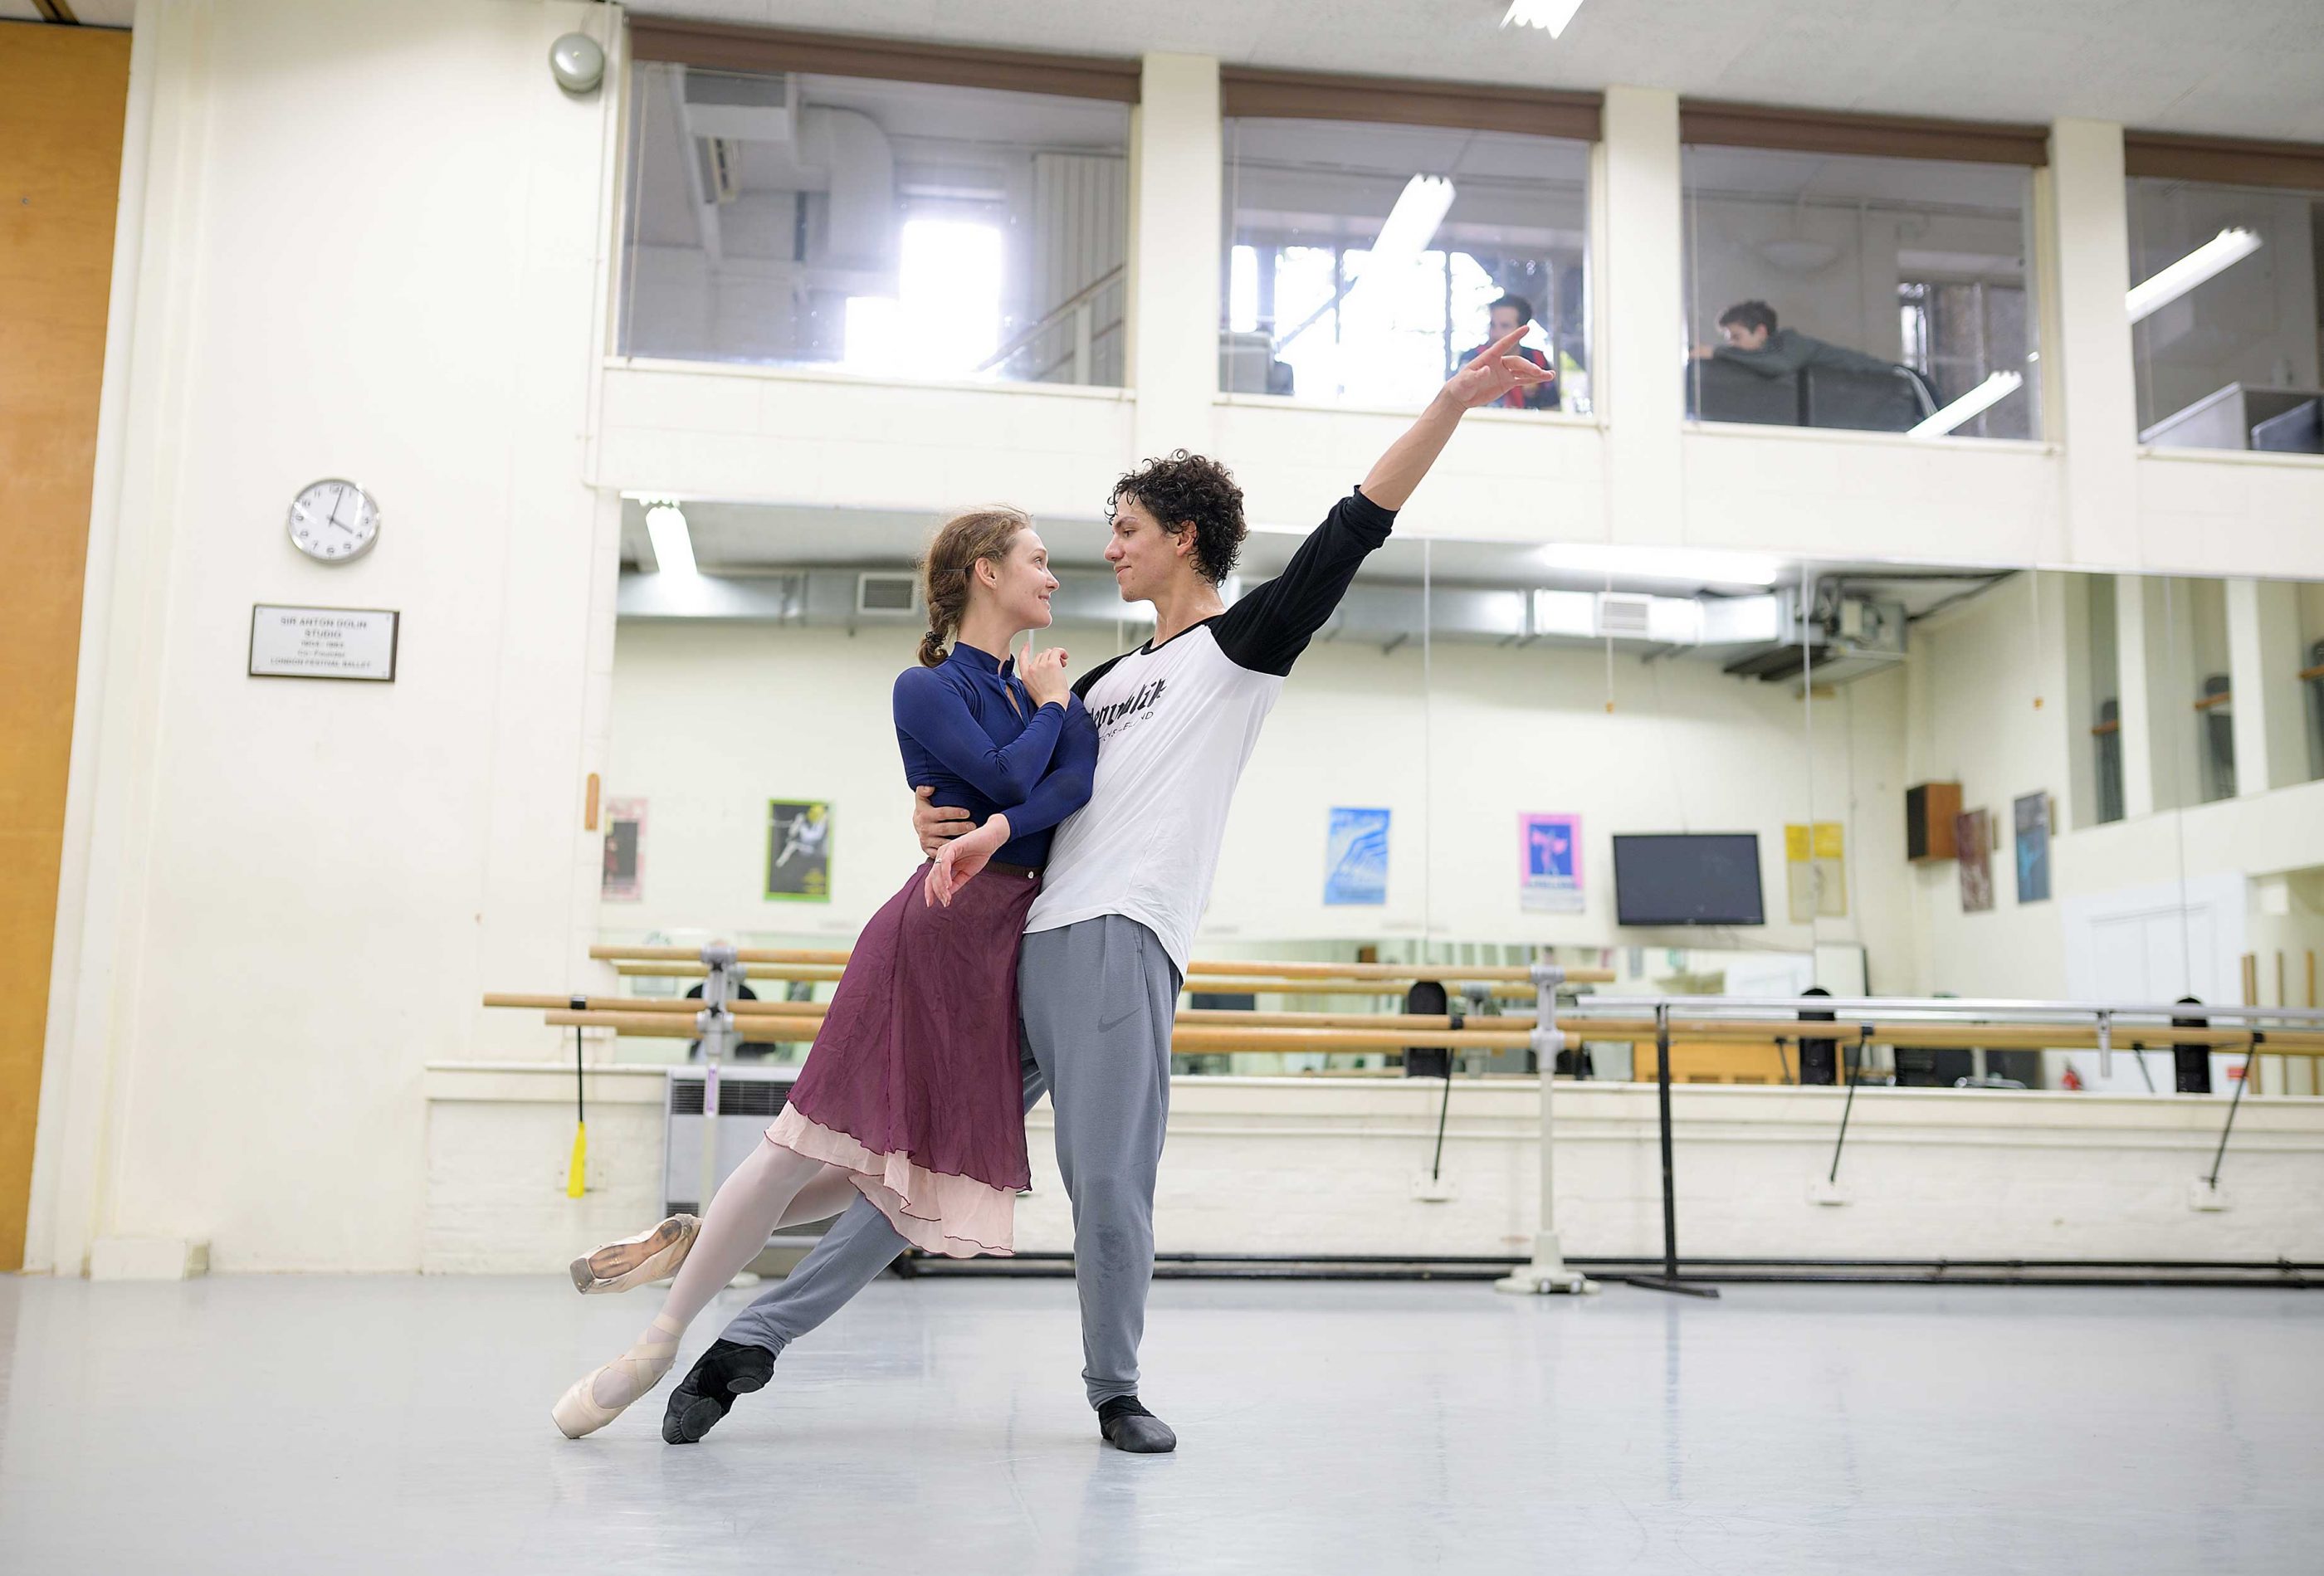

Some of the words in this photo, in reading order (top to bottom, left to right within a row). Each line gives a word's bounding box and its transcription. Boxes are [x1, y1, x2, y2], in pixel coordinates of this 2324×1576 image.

[281, 617, 296, 625] SIR
[299, 617, 334, 627] ANTON
[336, 618, 368, 629] DOLIN
[304, 629, 342, 638] STUDIO
